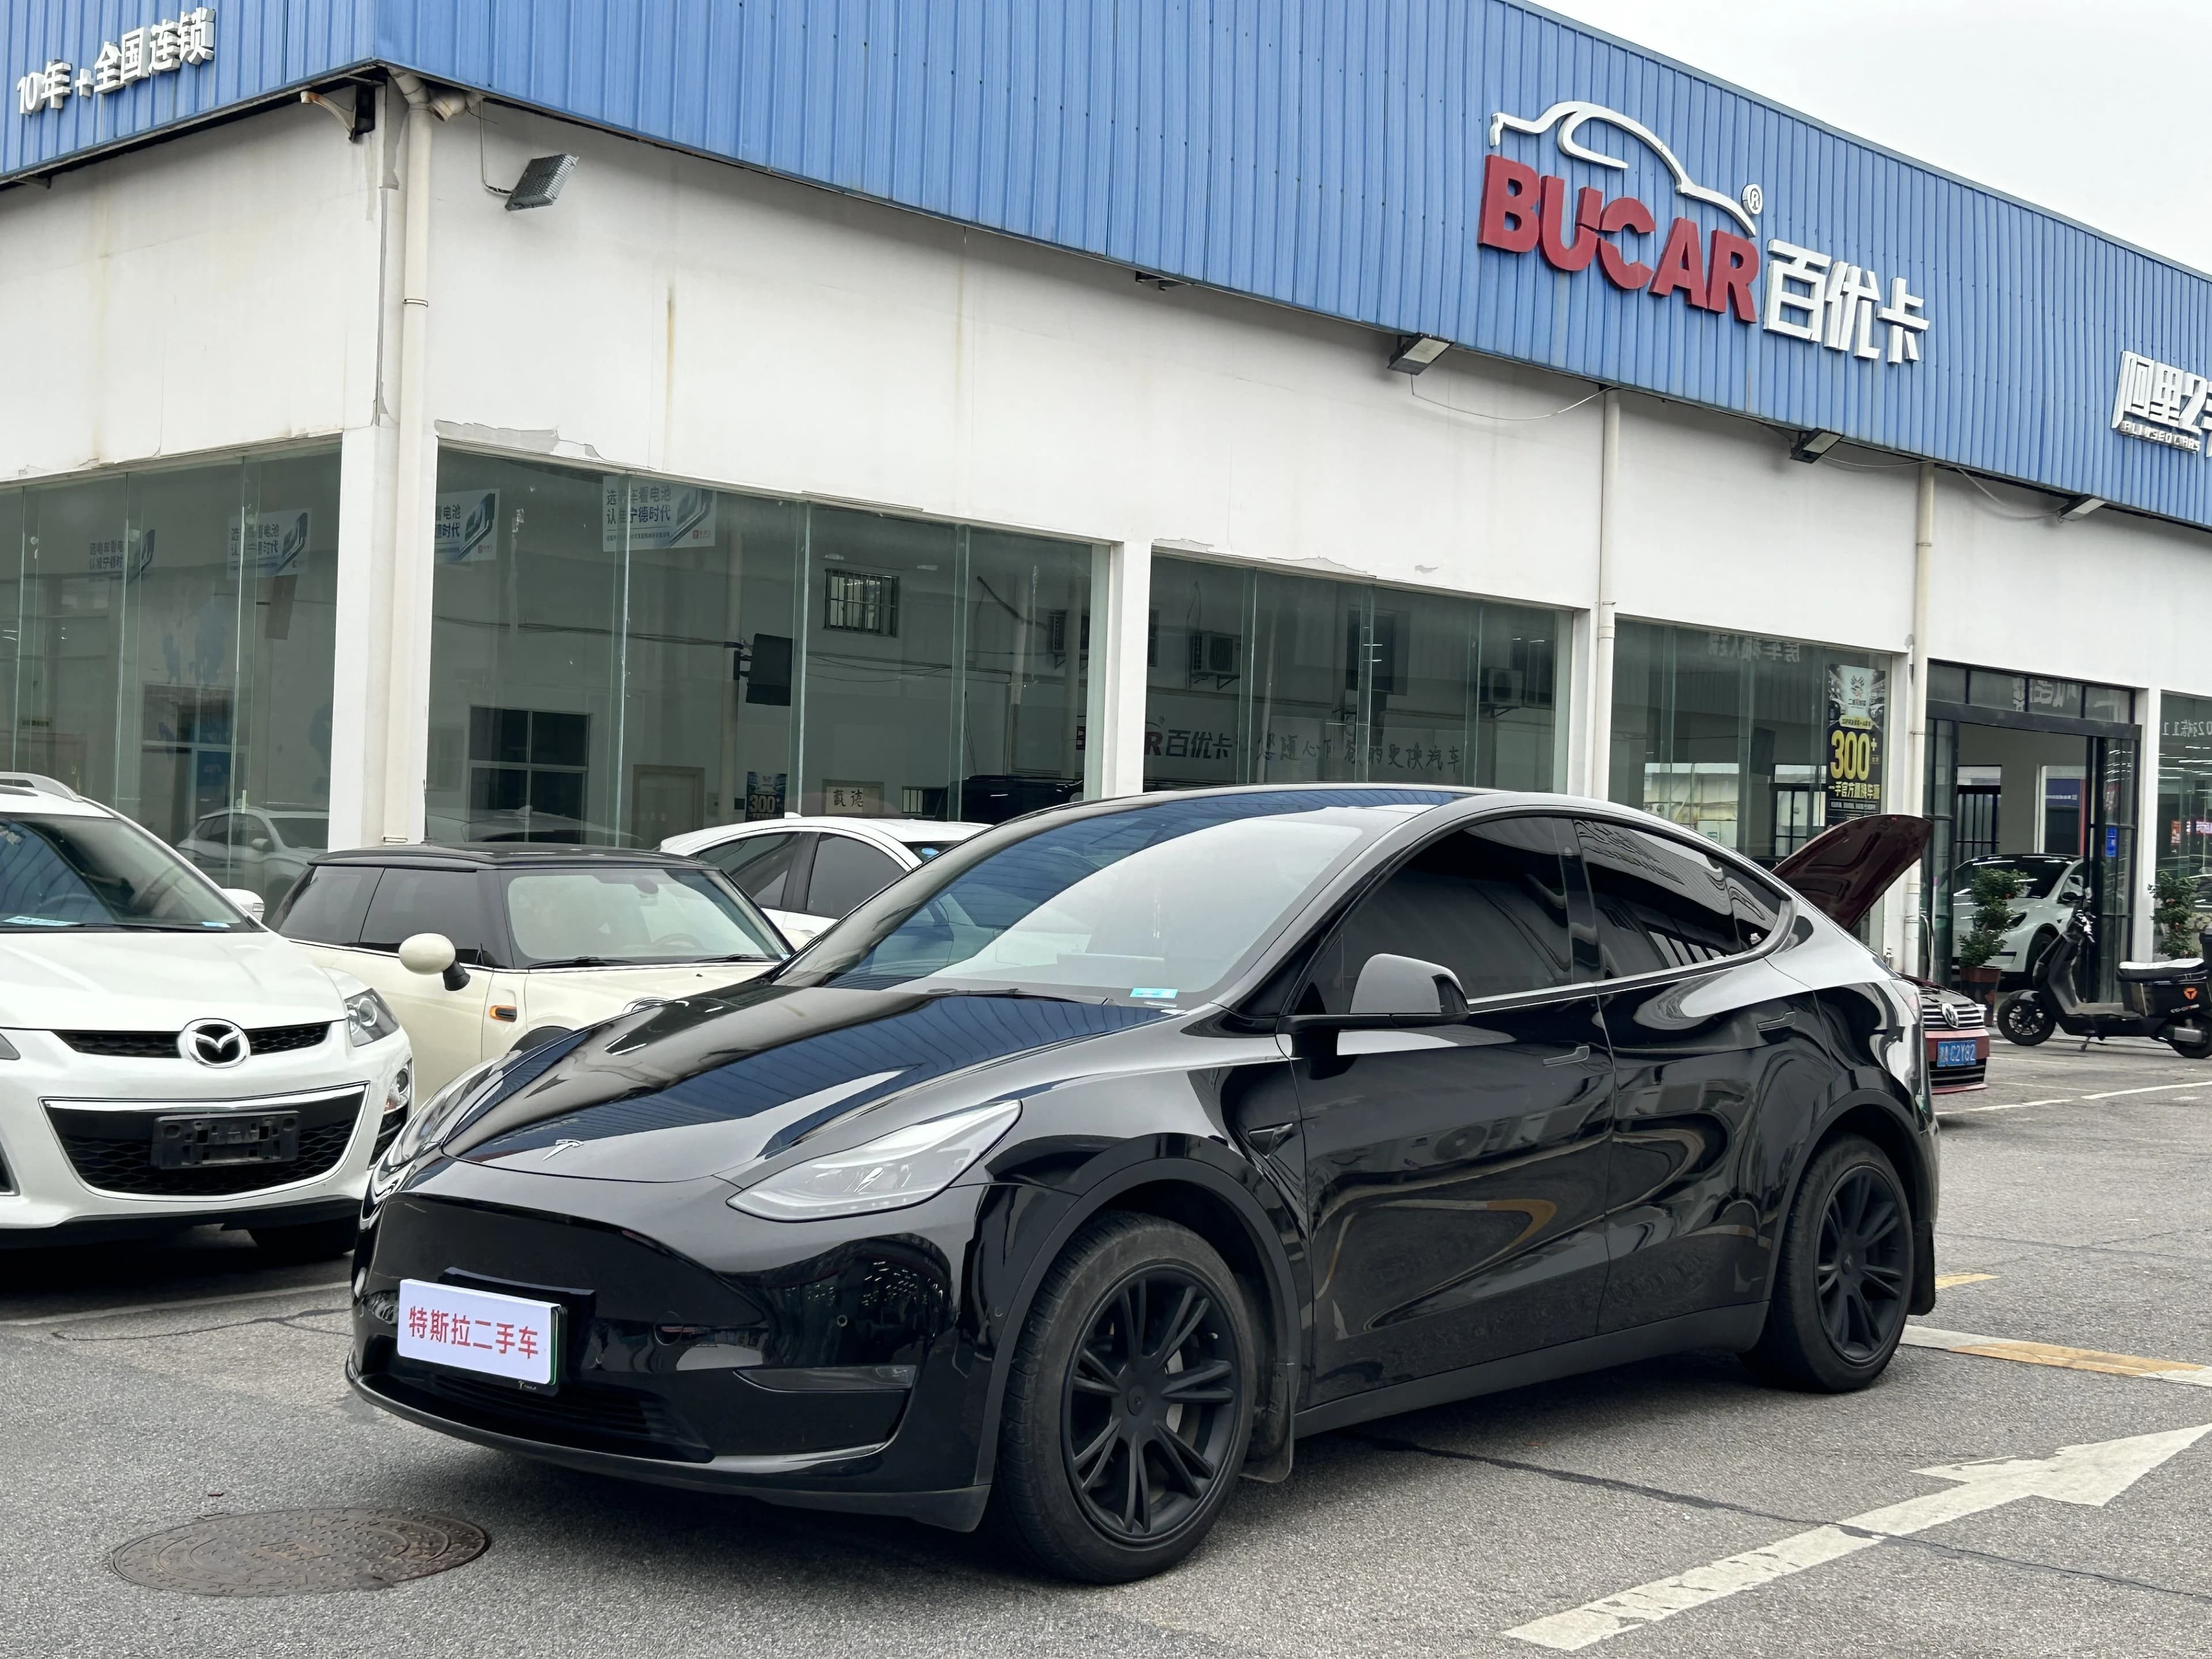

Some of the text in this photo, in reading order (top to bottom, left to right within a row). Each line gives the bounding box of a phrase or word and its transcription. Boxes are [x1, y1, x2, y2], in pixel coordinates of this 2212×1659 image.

[1478, 154, 1760, 324] BUCAR
[1763, 238, 1930, 365] 百优卡
[1166, 729, 1233, 759] 百优卡
[409, 1305, 539, 1359] 特斯拉二手车
